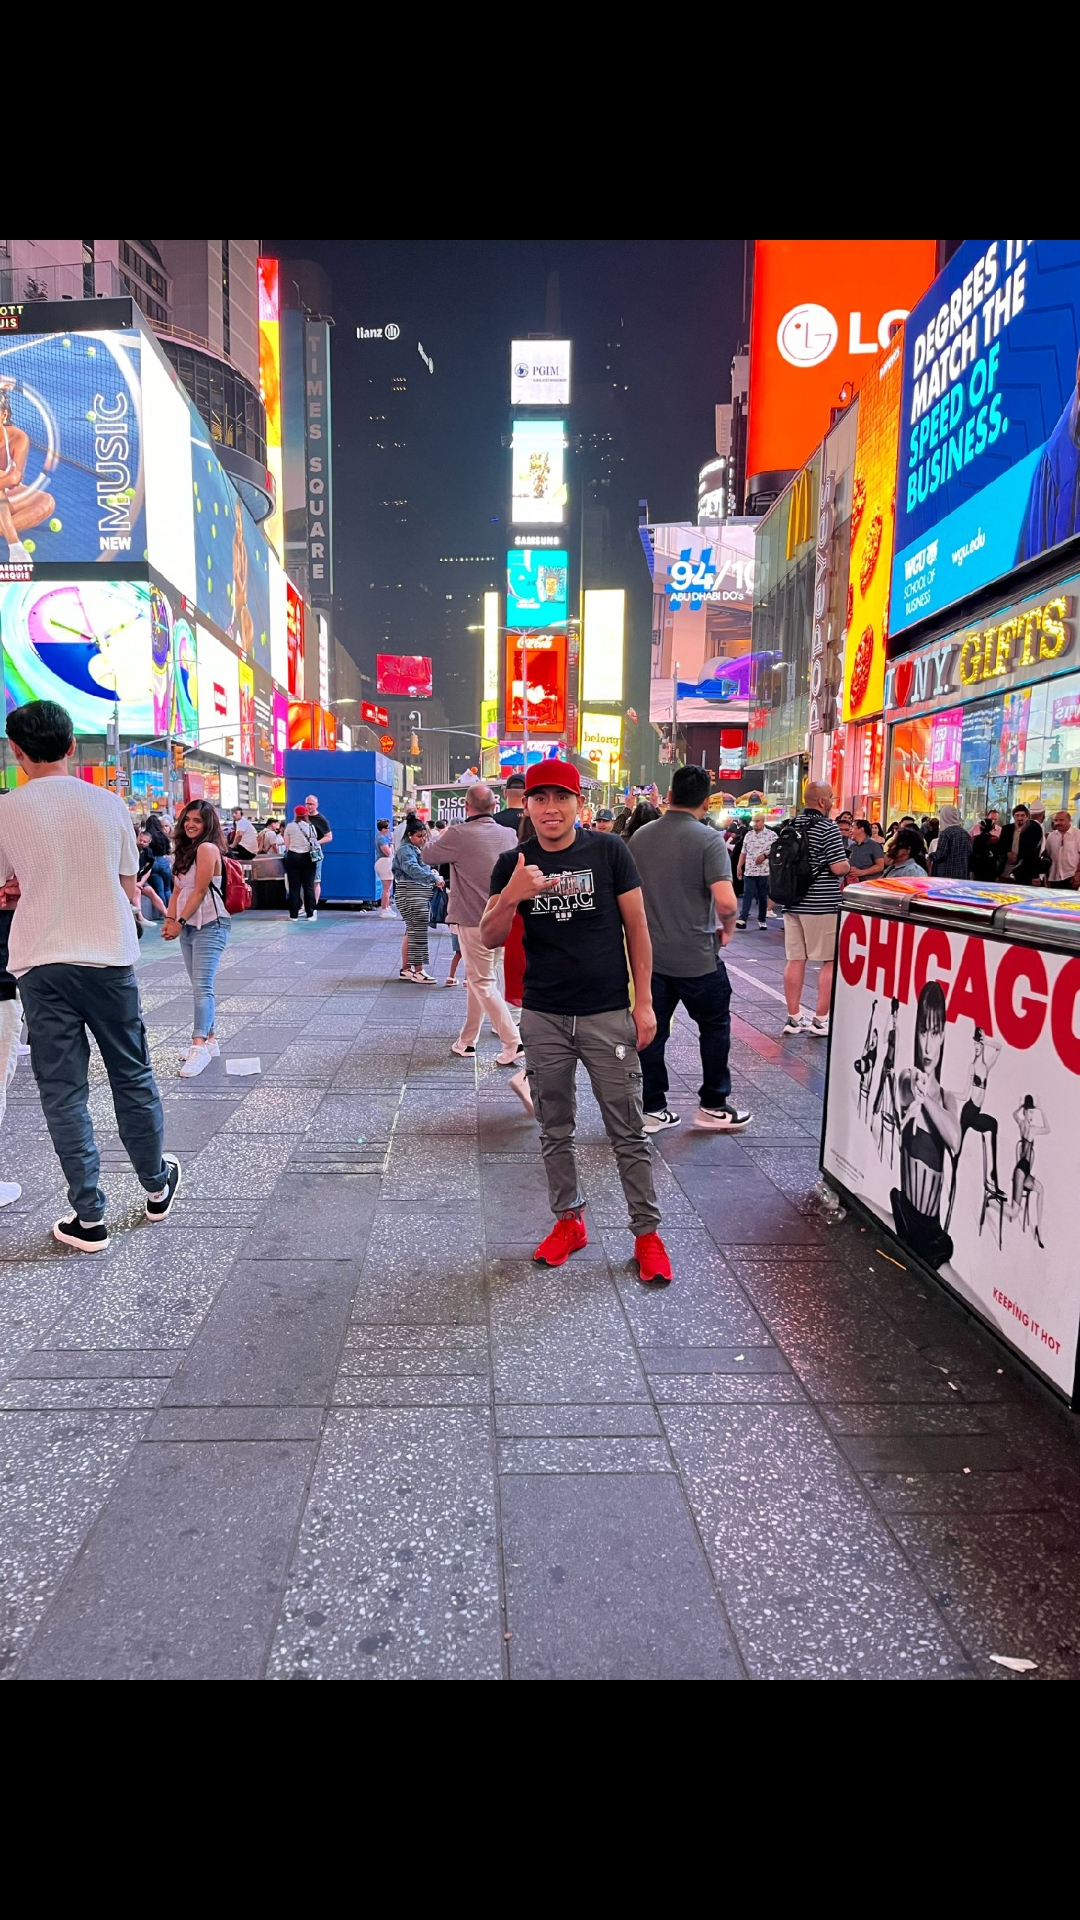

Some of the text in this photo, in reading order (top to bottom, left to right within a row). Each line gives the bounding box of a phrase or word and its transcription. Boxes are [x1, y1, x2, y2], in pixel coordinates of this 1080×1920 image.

[913, 241, 998, 379] DEGREES
[911, 314, 978, 426] MATCH
[983, 258, 1027, 347] THE
[533, 366, 559, 376] PGIM
[909, 340, 1000, 467] SPEED OF
[94, 392, 131, 531] MUSIC
[307, 336, 326, 579] TIMES SQUARE
[906, 393, 1009, 513] BUSINESS.
[100, 537, 131, 550] NEW
[514, 536, 560, 546] SAMSUNG
[951, 527, 986, 567] wgu.edu
[904, 548, 927, 581] WGU
[904, 568, 936, 599] SCHOOL OF
[670, 592, 690, 602] ABU
[692, 592, 721, 602] DHABI
[905, 589, 931, 616] BUSINESS
[959, 595, 1067, 685] GIFTS
[438, 794, 501, 810] DISCR
[992, 1286, 1062, 1355] KEEPING IT HOT
